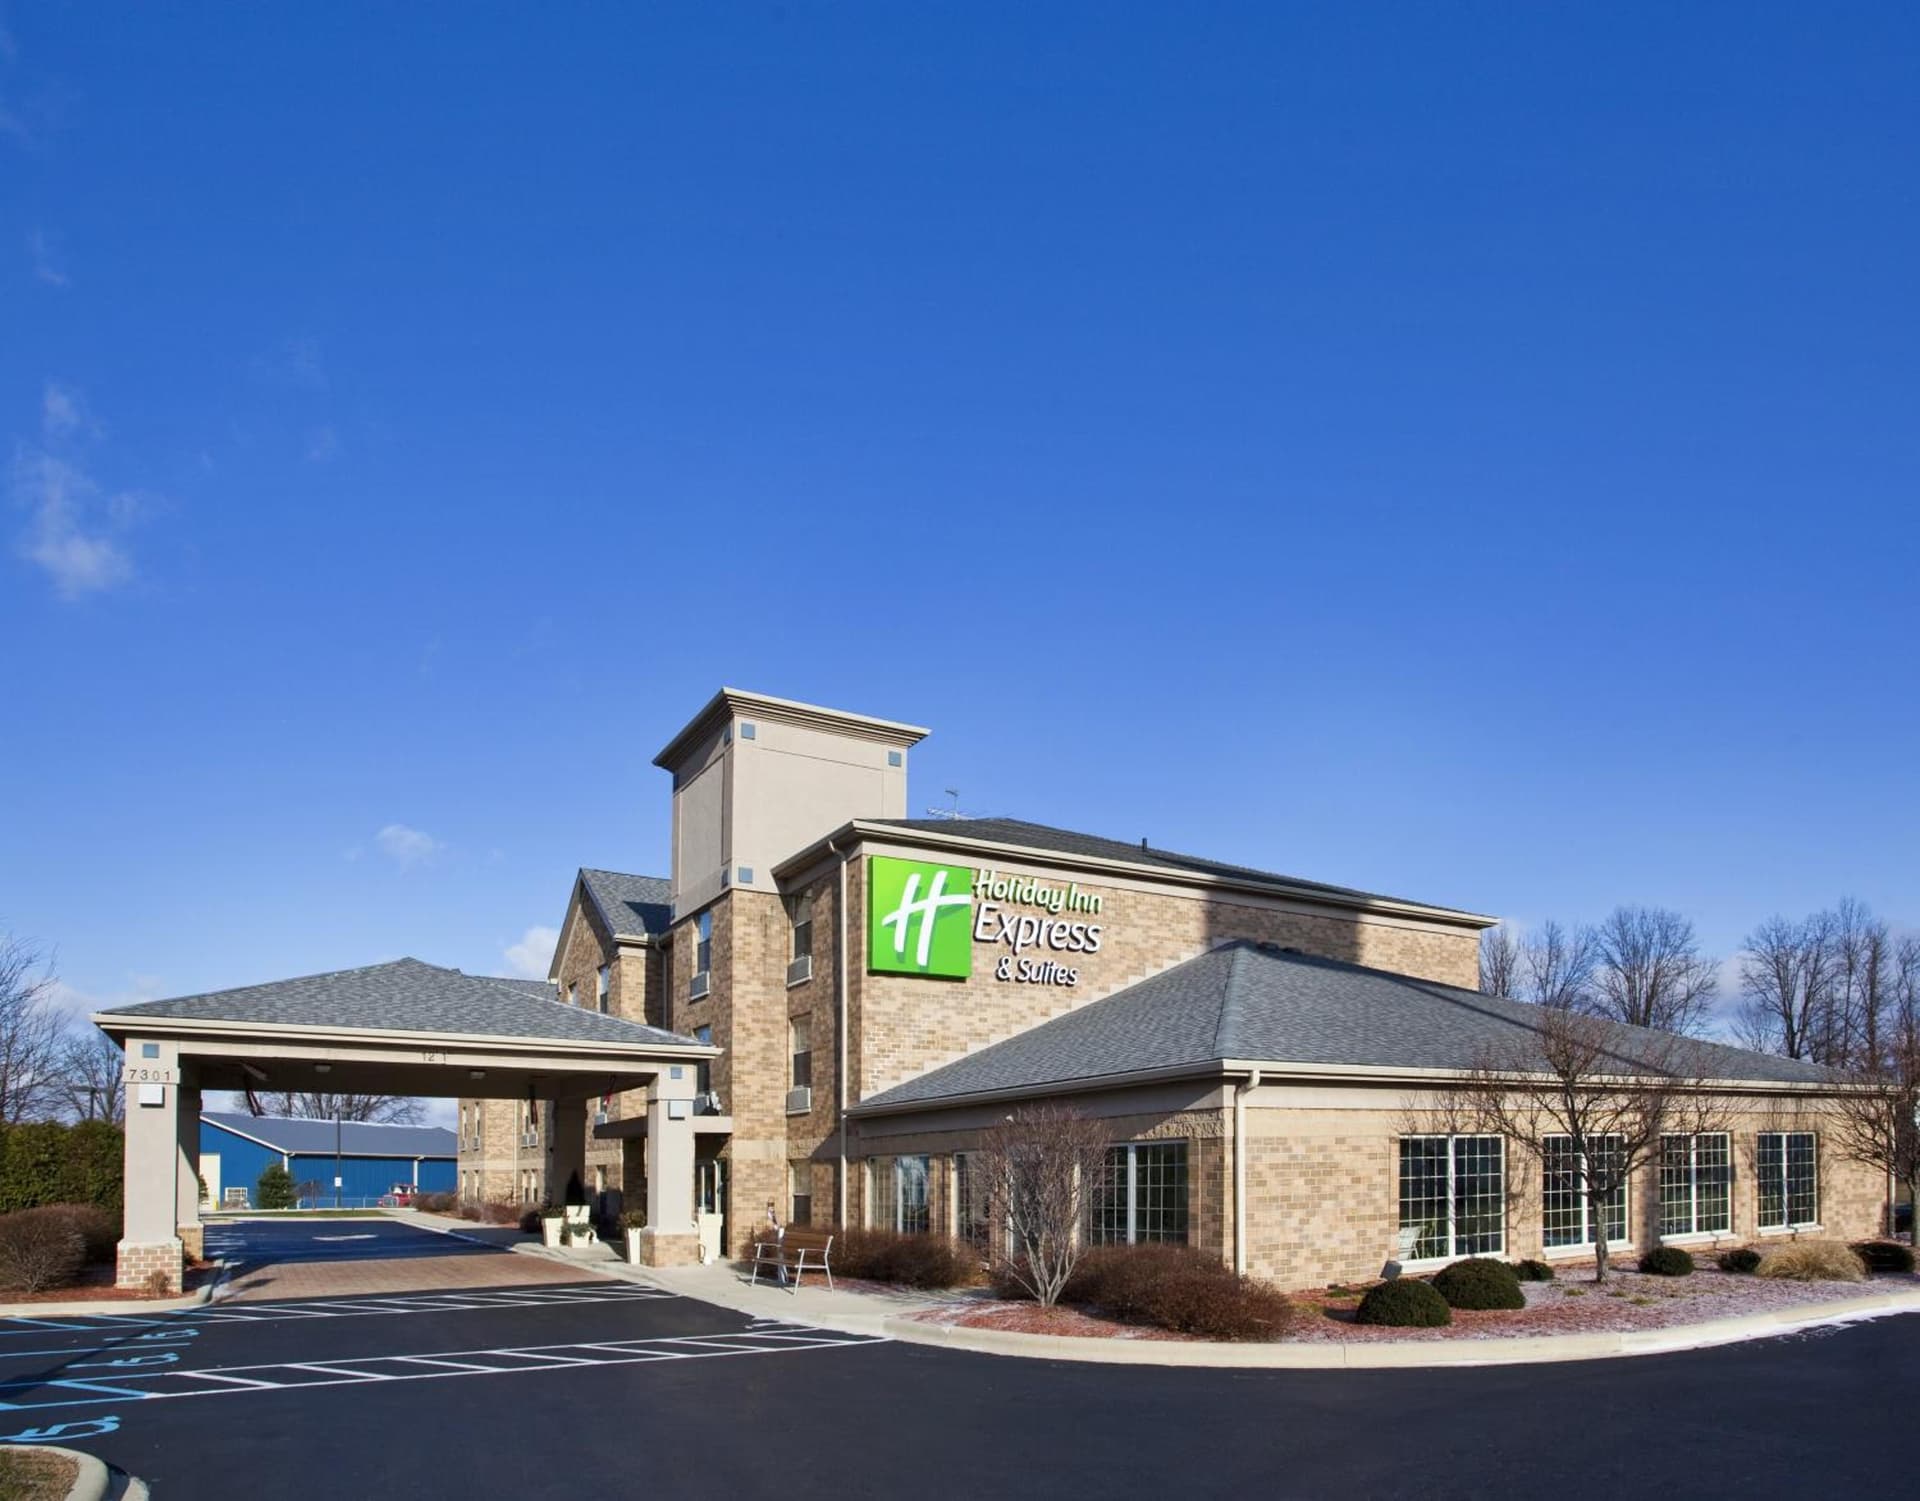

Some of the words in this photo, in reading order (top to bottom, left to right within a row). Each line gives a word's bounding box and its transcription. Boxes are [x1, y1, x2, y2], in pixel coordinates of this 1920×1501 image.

[974, 869, 1064, 914] Holiday
[1066, 882, 1103, 914] Inn
[973, 902, 1104, 956] Express
[996, 956, 1011, 981] &
[1016, 958, 1080, 987] Suites
[128, 1068, 171, 1082] 7301
